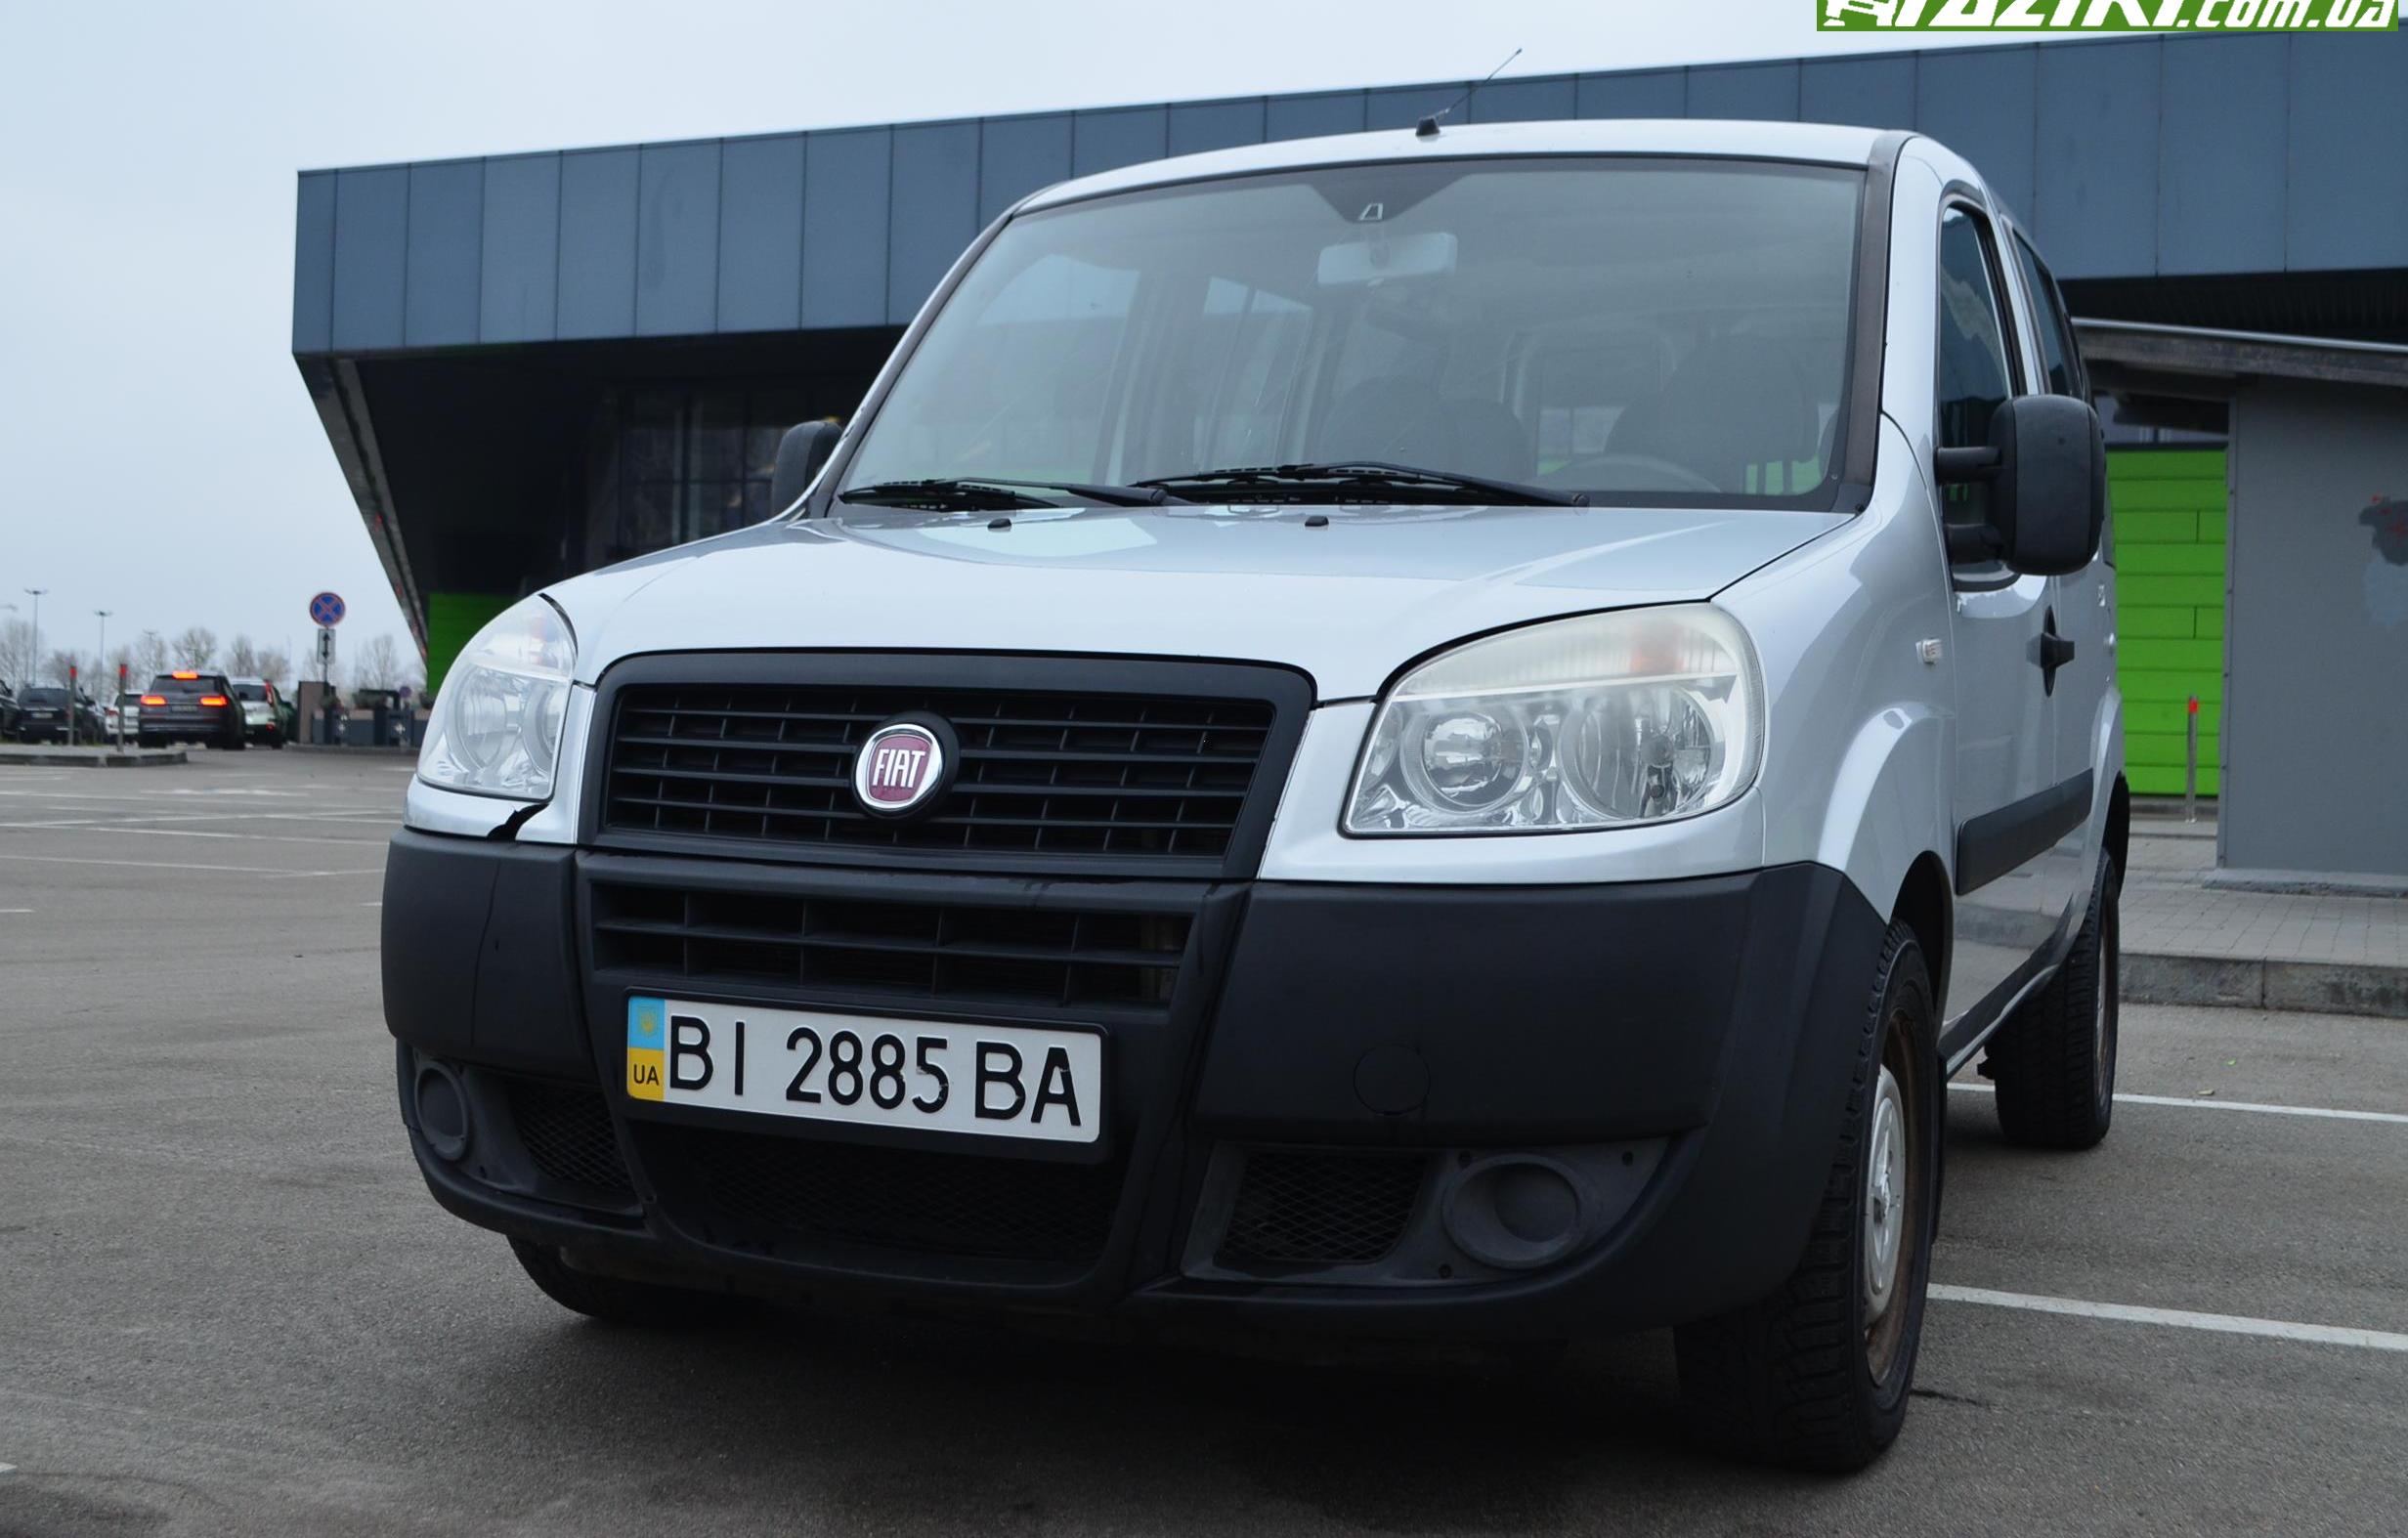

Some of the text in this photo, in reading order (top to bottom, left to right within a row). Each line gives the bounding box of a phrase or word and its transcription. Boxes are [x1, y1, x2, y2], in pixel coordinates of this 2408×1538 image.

[872, 748, 926, 789] FIAT
[633, 1063, 660, 1087] UA
[669, 1014, 1083, 1127] BI 2885 BA
